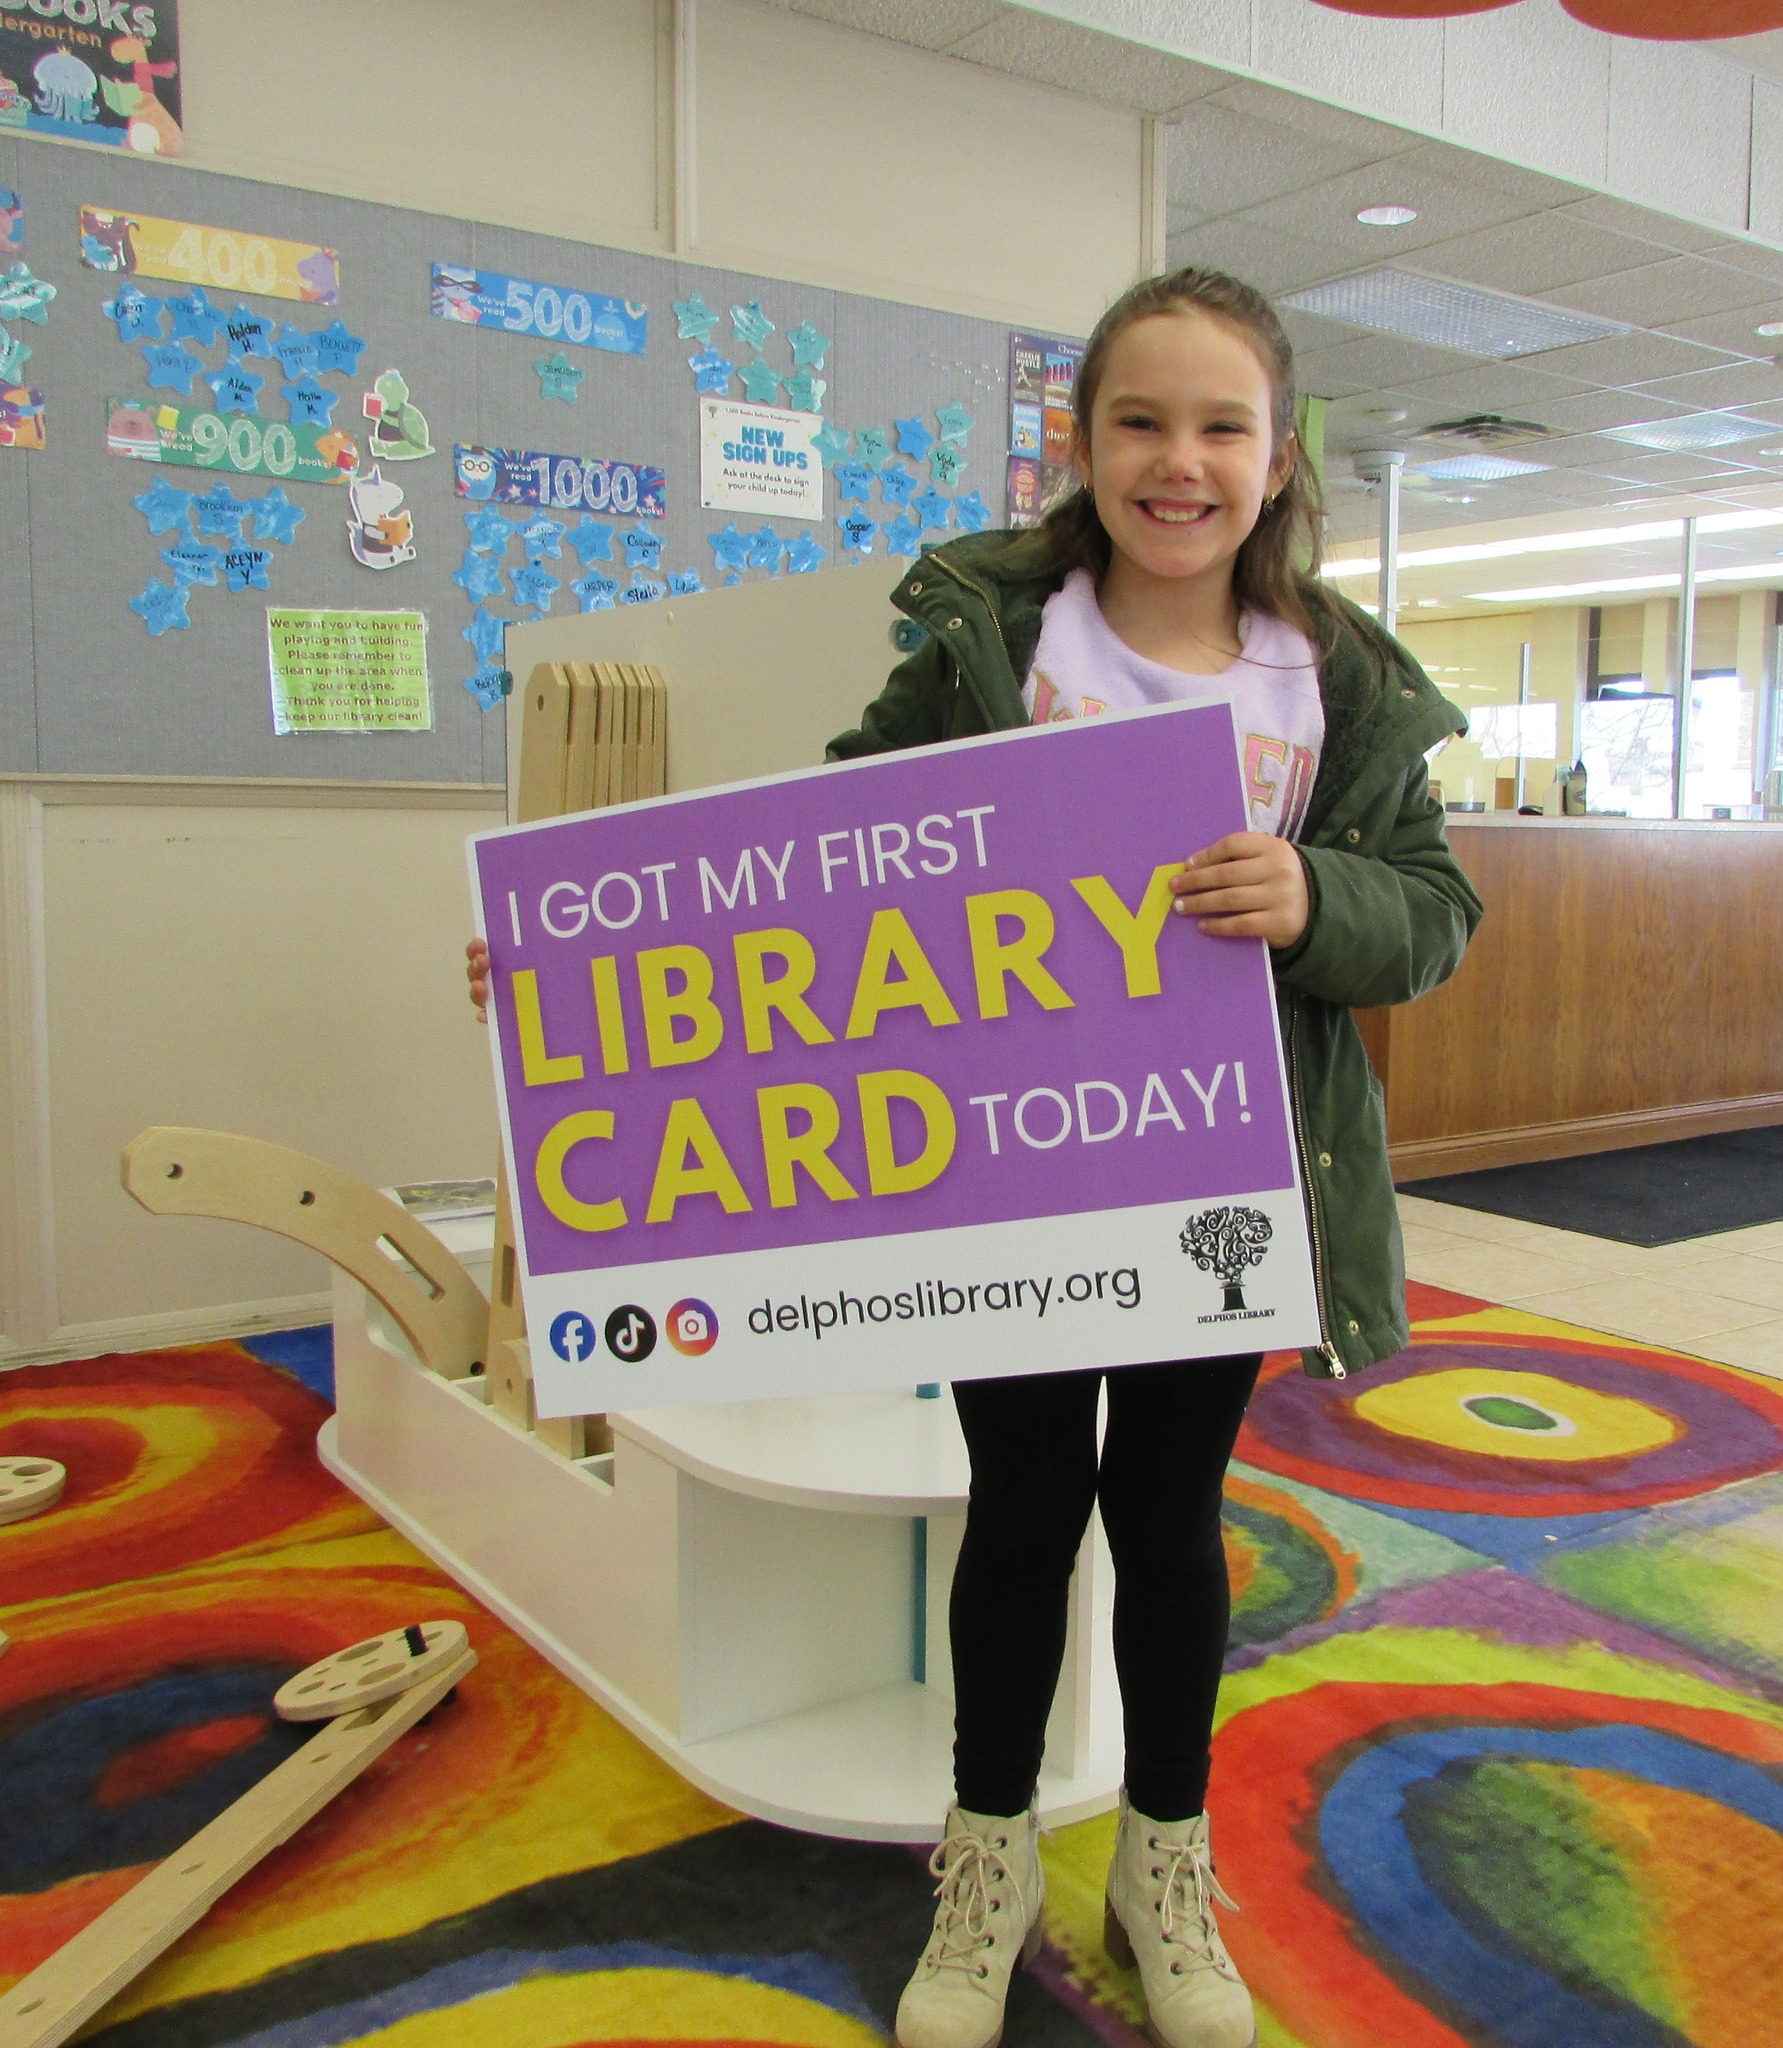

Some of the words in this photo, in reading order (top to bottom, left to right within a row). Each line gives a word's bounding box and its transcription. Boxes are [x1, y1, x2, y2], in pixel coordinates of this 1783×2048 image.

[0, 0, 157, 37] OOKS
[0, 13, 102, 48] ergarten
[167, 226, 277, 294] 400
[503, 280, 593, 343] 500
[192, 413, 297, 476] 900
[741, 426, 785, 448] NEW
[298, 456, 333, 469] books!
[722, 441, 768, 465] SIGN
[772, 448, 808, 471] UPS
[510, 472, 533, 482] read
[530, 456, 638, 513] 1000
[722, 468, 738, 477] Ask
[750, 471, 762, 480] the
[764, 473, 782, 482] desk
[784, 476, 792, 484] to
[794, 477, 810, 488] sign
[728, 482, 746, 490] your
[748, 482, 767, 492] child
[768, 487, 778, 496] up
[780, 488, 805, 499] today!
[271, 618, 290, 629] We
[294, 619, 326, 629] want
[330, 620, 352, 632] you
[356, 621, 368, 630] to
[372, 620, 401, 631] have
[405, 621, 424, 631] fun
[284, 635, 330, 647] playing
[334, 636, 356, 645] and
[360, 636, 413, 647] building.
[288, 650, 330, 660] Please
[333, 650, 395, 661] remember
[400, 651, 412, 661] to
[279, 665, 312, 675] clean
[316, 667, 333, 677] up
[336, 665, 357, 676] the
[359, 667, 386, 676] area
[390, 667, 422, 677] when
[311, 682, 333, 693] you
[337, 682, 357, 691] are
[361, 681, 395, 691] done.
[287, 696, 325, 706] Thank
[329, 698, 350, 708] you
[353, 696, 373, 706] for
[376, 697, 420, 708] helping
[285, 712, 315, 722] keep
[320, 713, 338, 721] our
[343, 712, 384, 723] library
[387, 712, 423, 722] clean!
[508, 891, 522, 947] I
[539, 862, 676, 939] GOT
[698, 840, 795, 914] MY
[818, 805, 996, 892] FIRST
[511, 862, 1187, 1088] LIBRARY
[535, 1069, 957, 1233] CARD
[969, 1061, 1252, 1155] TODAY!
[747, 1265, 1141, 1340] delphoslibrary.org
[1197, 1311, 1238, 1325] DELPHOS
[1238, 1307, 1277, 1321] LIBRARY
